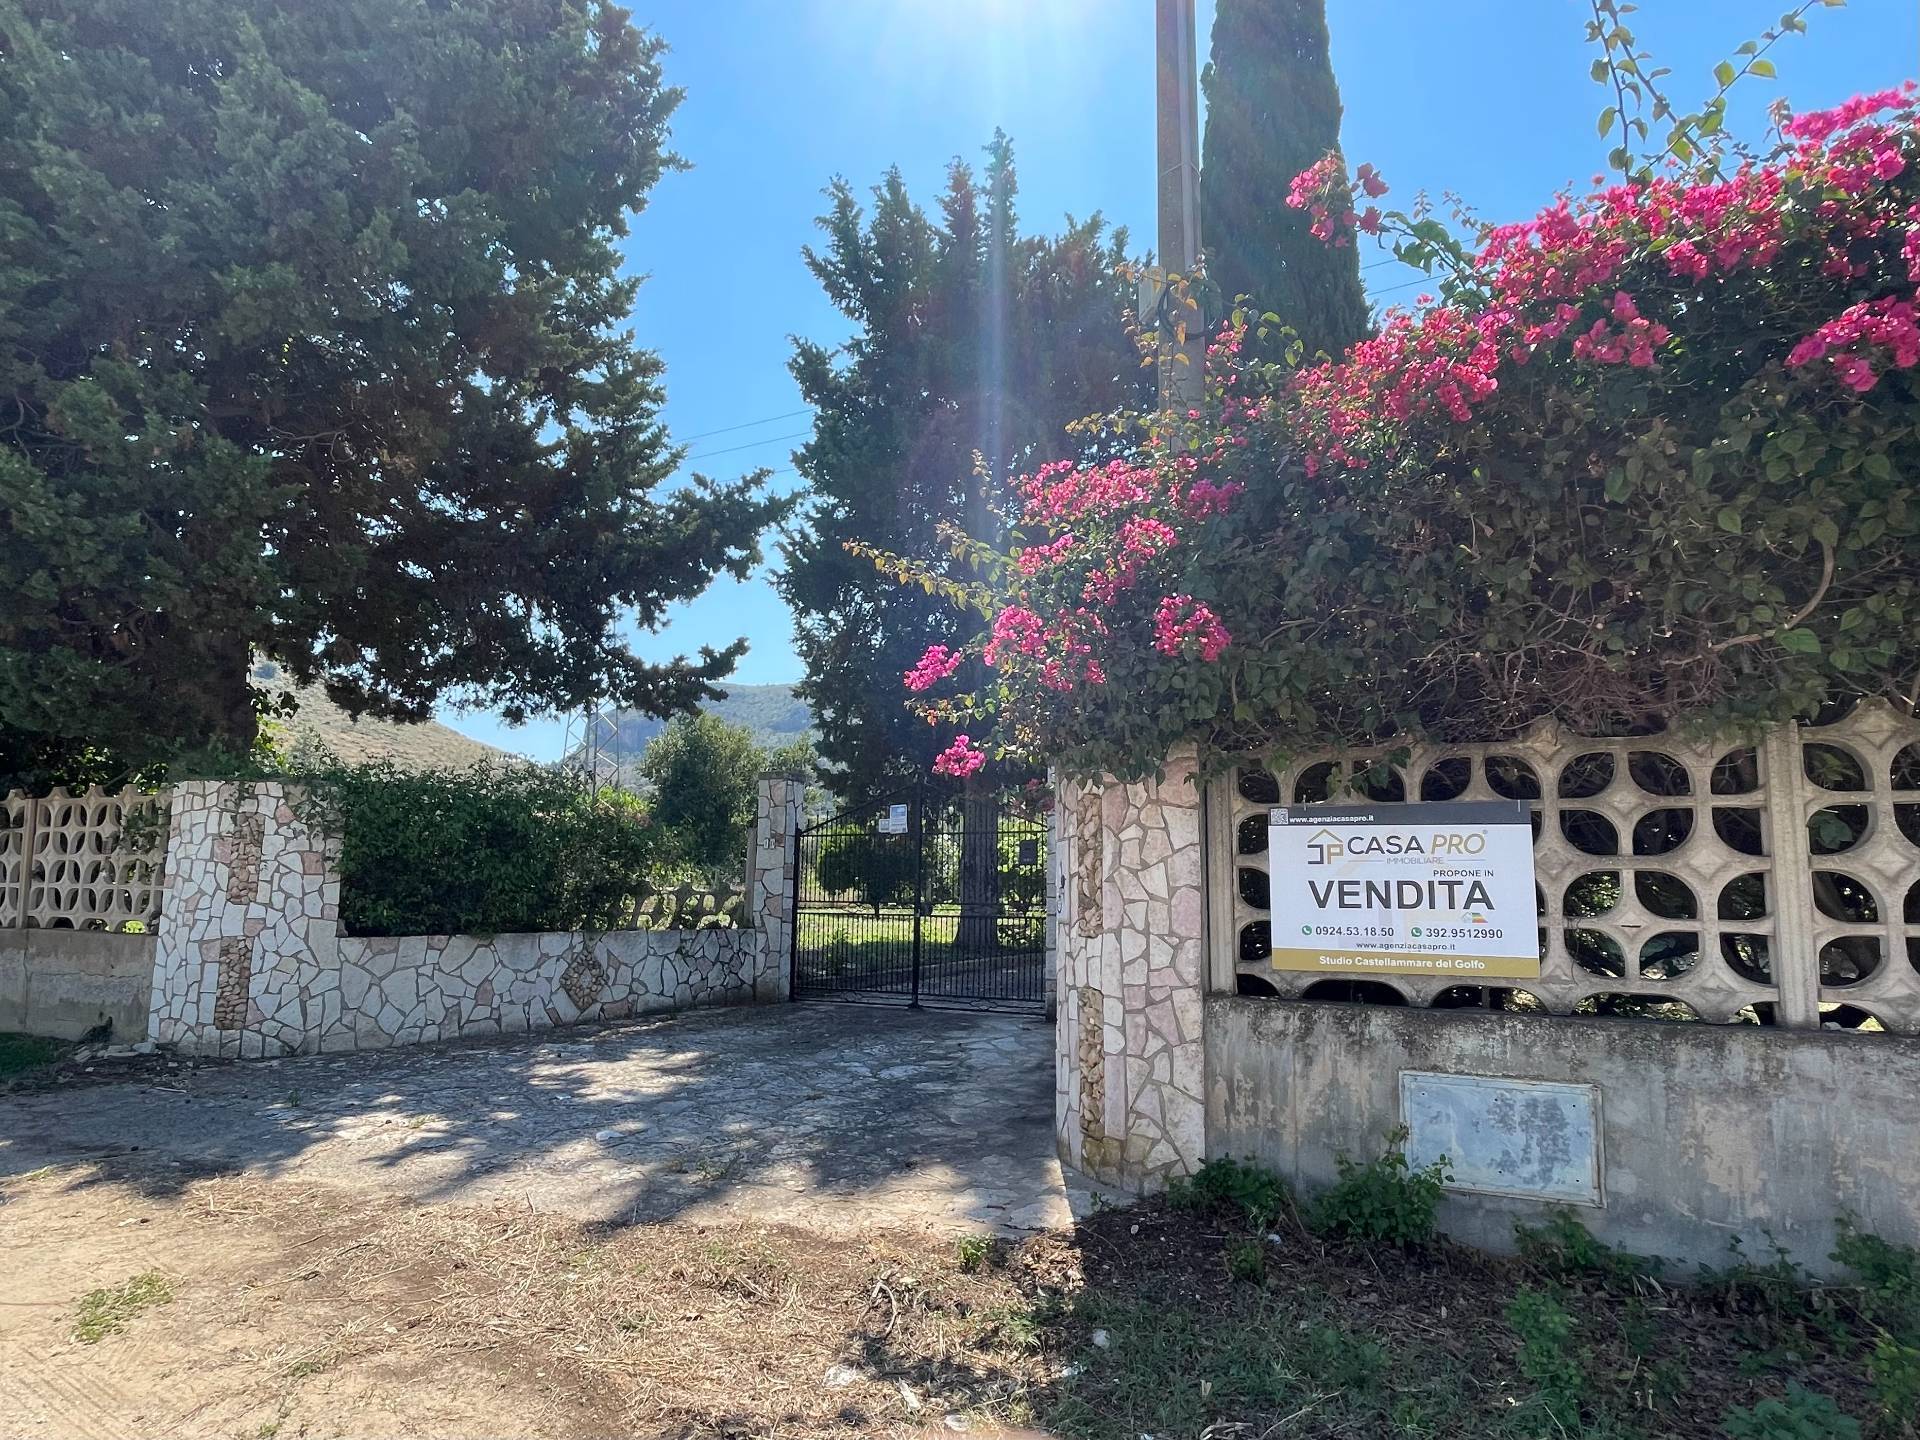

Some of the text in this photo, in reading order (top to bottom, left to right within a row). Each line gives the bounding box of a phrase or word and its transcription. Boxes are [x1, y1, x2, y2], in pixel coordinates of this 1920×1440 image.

[1289, 814, 1374, 823] www.agenziacasapro.it
[1347, 833, 1486, 855] CASA PRO
[1386, 856, 1445, 865] IMMOBILIARE
[1433, 869, 1494, 877] PROPONE IN
[1308, 880, 1496, 910] VENDITA
[1315, 926, 1395, 937] 0924.53.18.50
[1424, 927, 1503, 938] 392.9512990
[1356, 942, 1456, 951] www.agenziacasapro.it
[1319, 956, 1486, 970] Studio Castellammare del Golfo
